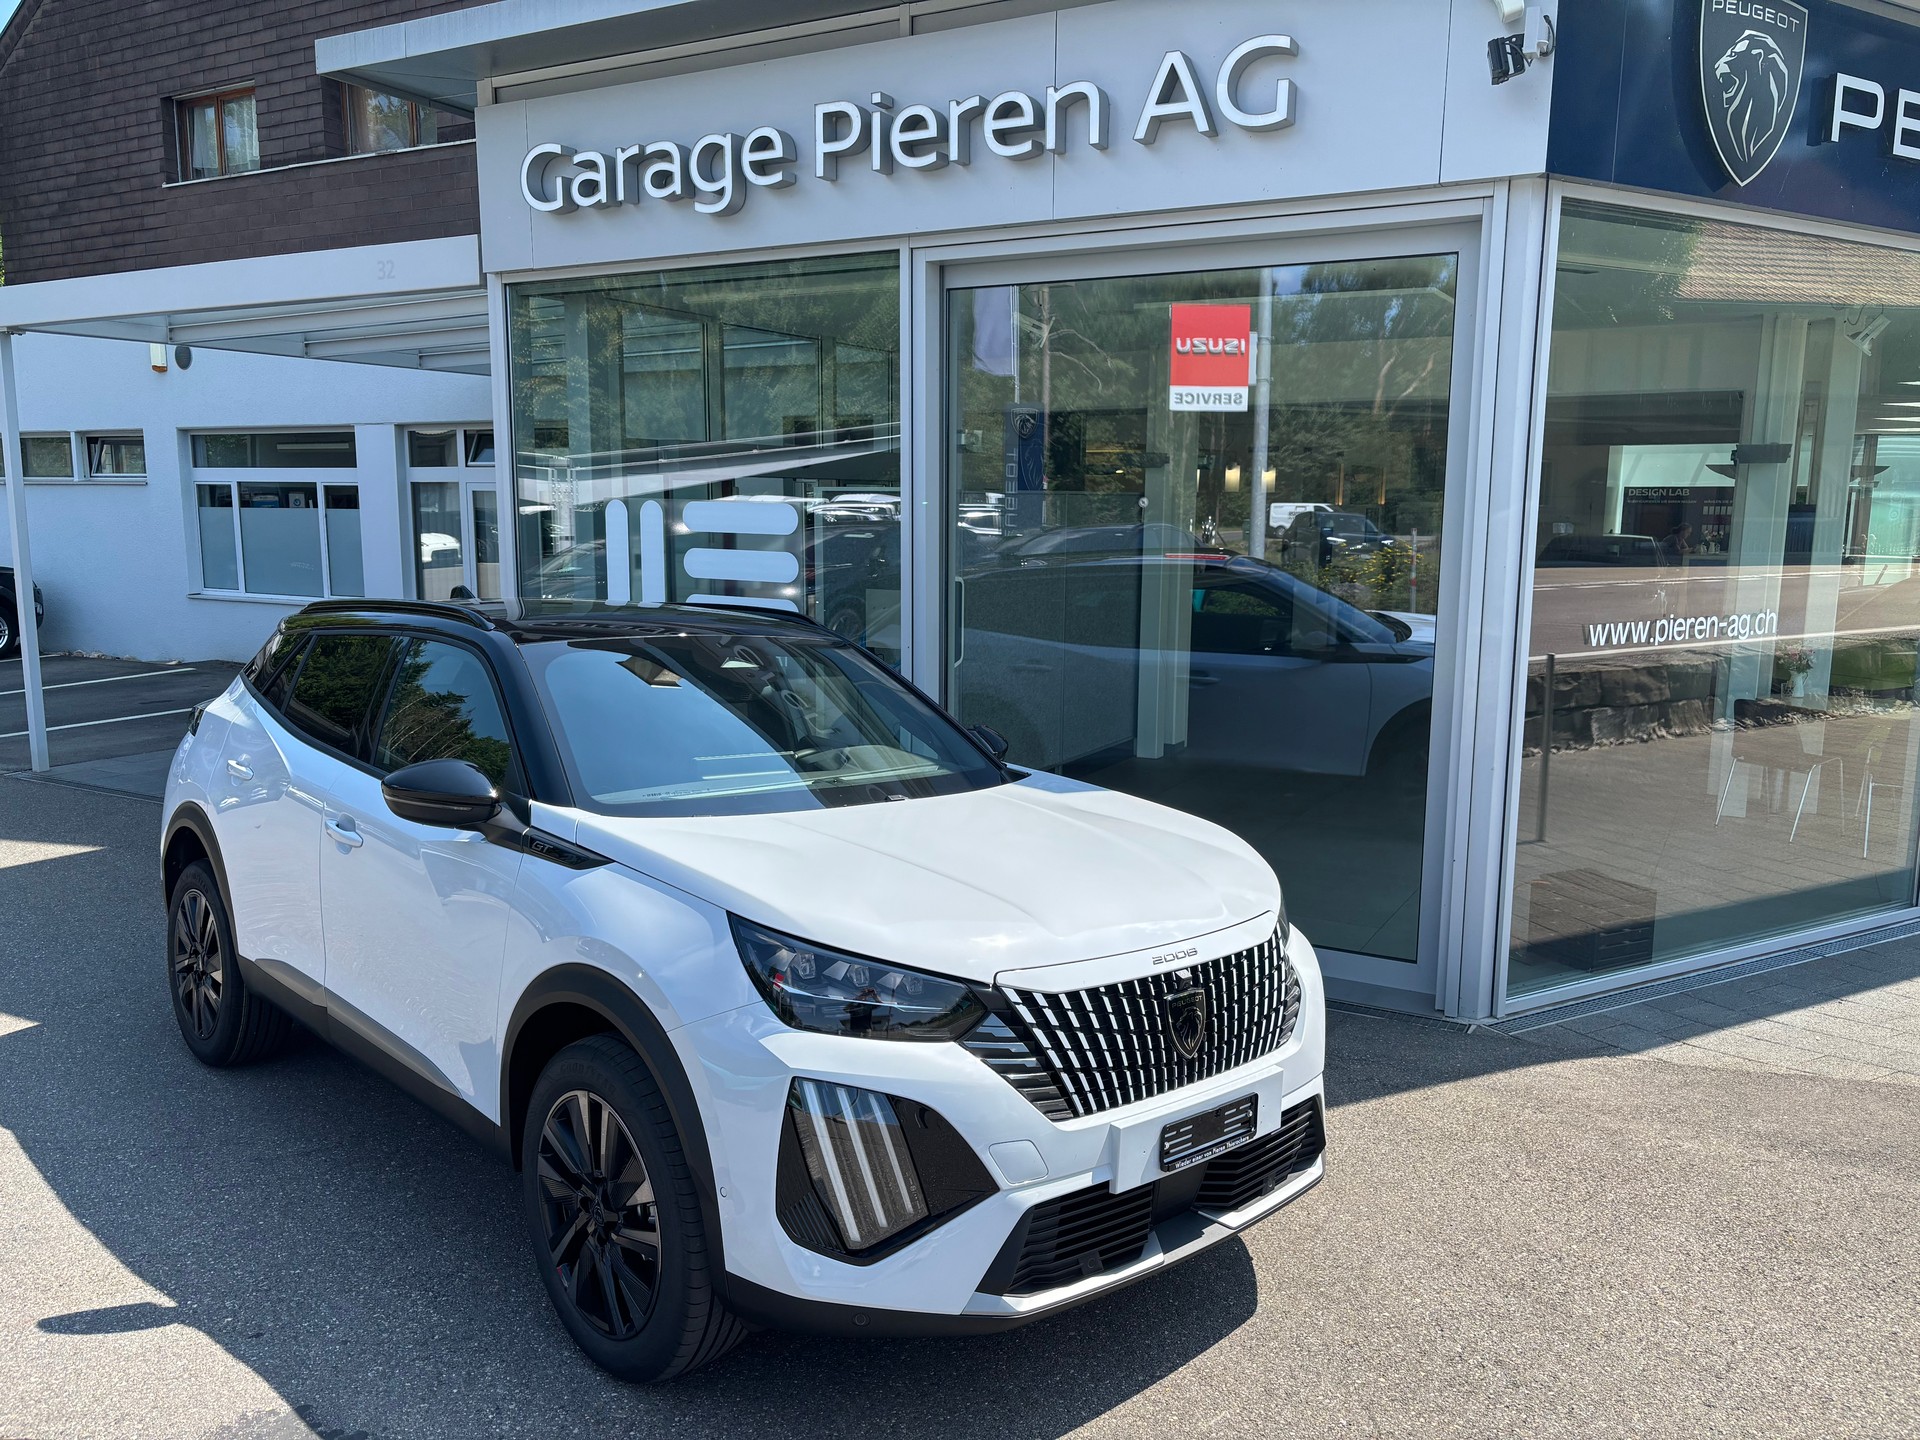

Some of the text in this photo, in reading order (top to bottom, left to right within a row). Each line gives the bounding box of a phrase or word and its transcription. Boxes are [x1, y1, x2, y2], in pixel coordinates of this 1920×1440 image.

[1712, 0, 1800, 32] PEUGEOT
[519, 33, 1299, 217] Garage Pieren AG
[377, 260, 396, 280] 32
[1628, 488, 1690, 496] DESIGN LAB
[1588, 608, 1778, 647] www.pieren-ag.ch
[531, 840, 554, 853] GT
[1175, 1157, 1191, 1169] Wieder
